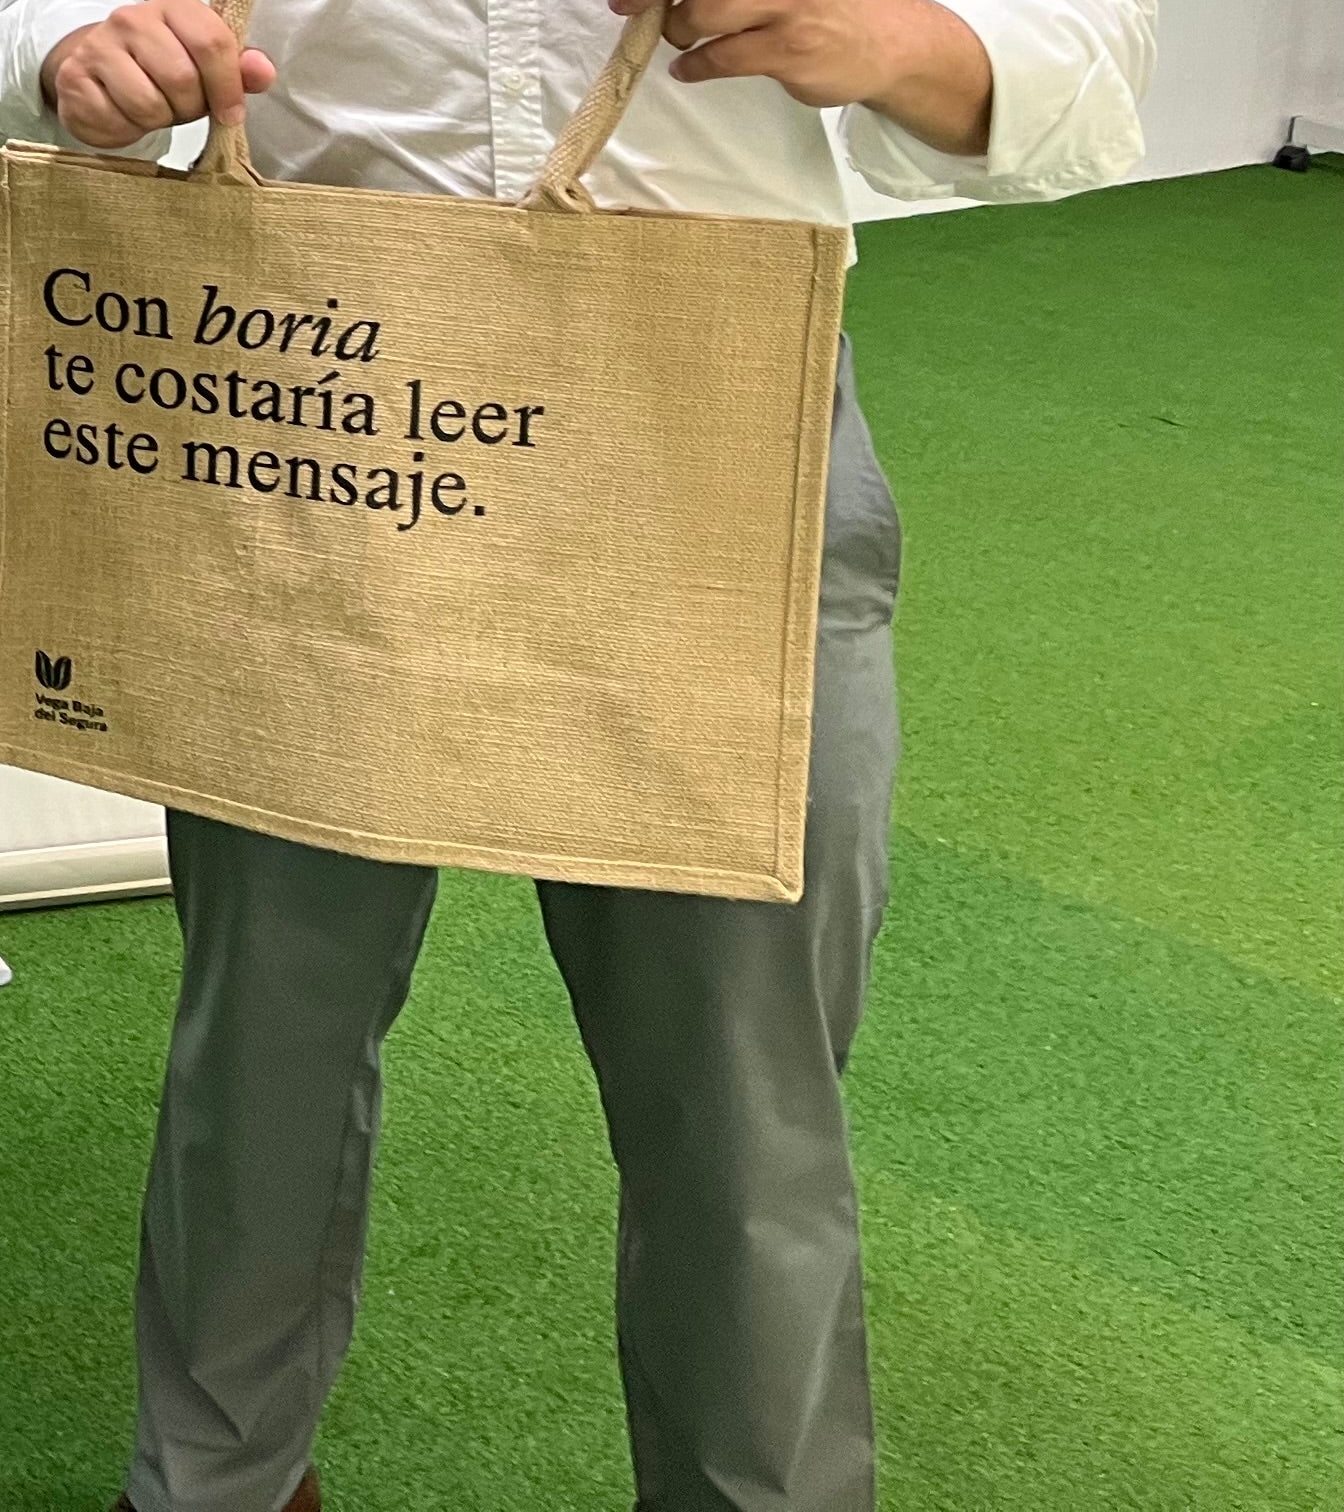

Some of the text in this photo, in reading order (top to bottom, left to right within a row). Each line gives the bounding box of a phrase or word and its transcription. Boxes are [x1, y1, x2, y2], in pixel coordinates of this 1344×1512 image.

[42, 268, 382, 363] Con boria
[45, 343, 545, 448] te costaría leer
[43, 416, 487, 532] este mensaje.
